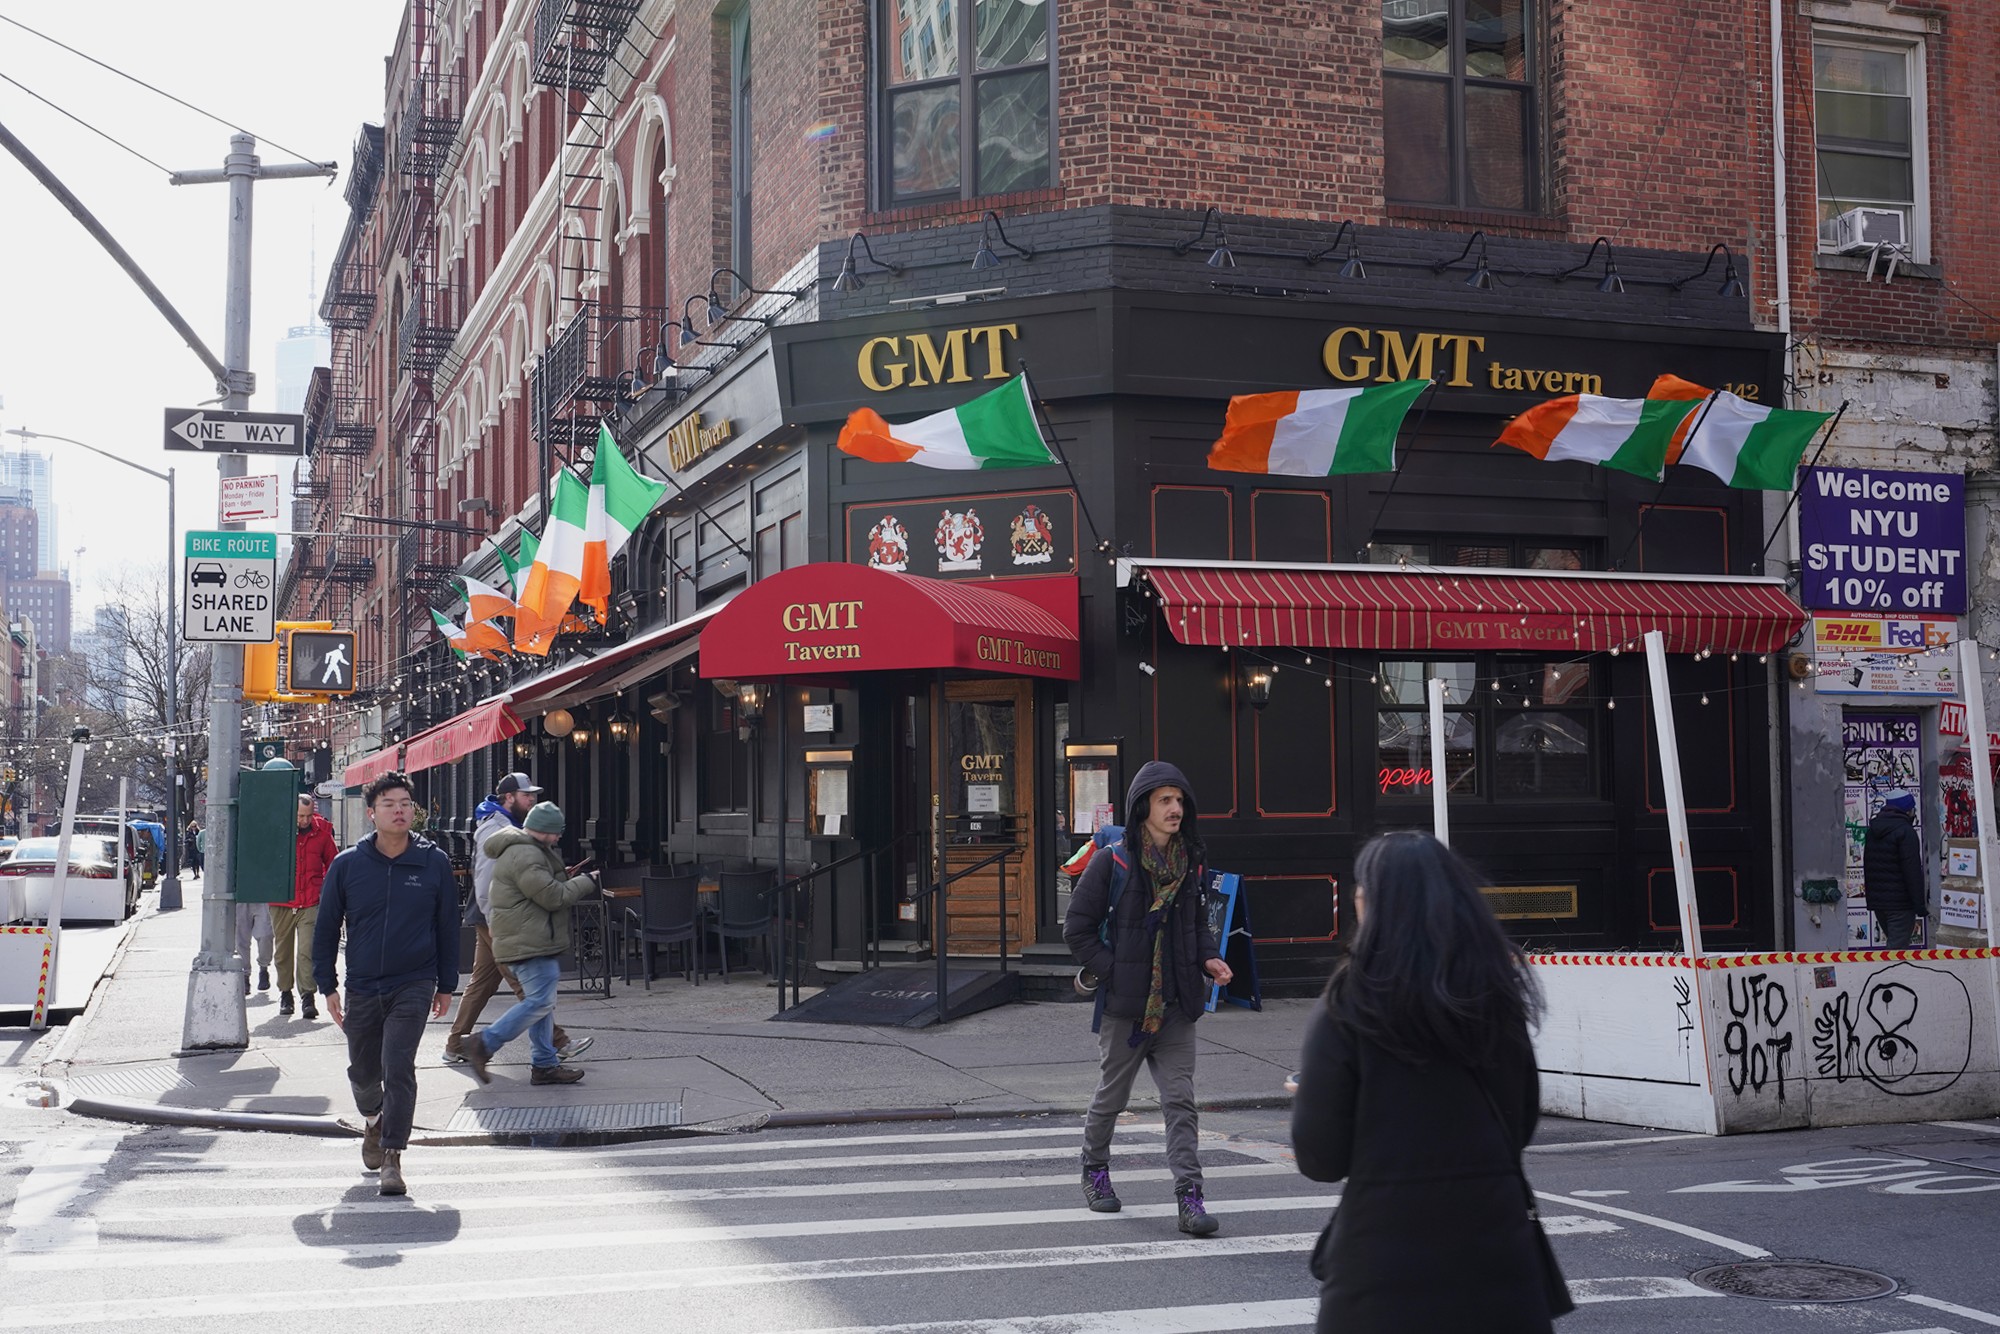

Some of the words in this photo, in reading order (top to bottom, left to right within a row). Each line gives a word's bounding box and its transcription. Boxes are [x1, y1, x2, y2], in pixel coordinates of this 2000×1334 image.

[857, 323, 1020, 392] GMT
[1323, 326, 1485, 387] GMT
[1488, 361, 1603, 395] tavern
[186, 422, 225, 440] ONE
[245, 425, 286, 442] WAY
[667, 410, 702, 473] GMT
[224, 481, 234, 490] NO
[235, 479, 265, 489] PARKING
[248, 490, 265, 498] Friday
[1816, 471, 1951, 502] Welcome
[1850, 509, 1919, 537] NYU
[192, 538, 221, 552] BIKE
[228, 538, 270, 553] ROUTE
[1808, 543, 1961, 575] STUDENT
[191, 594, 268, 611] SHARED
[1825, 577, 1892, 608] 10%
[1902, 581, 1945, 608] off
[204, 616, 255, 633] LANE
[782, 600, 864, 633] GMT
[1435, 620, 1489, 640] GMT
[1494, 622, 1570, 641] Tavern
[1825, 623, 1873, 641] DHL
[1887, 622, 1950, 647] FedEx
[784, 641, 862, 662] Tavern
[976, 634, 1012, 664] GMT
[1012, 641, 1062, 670] Tavern
[961, 754, 1004, 770] GMT
[962, 771, 1003, 782] Tavern
